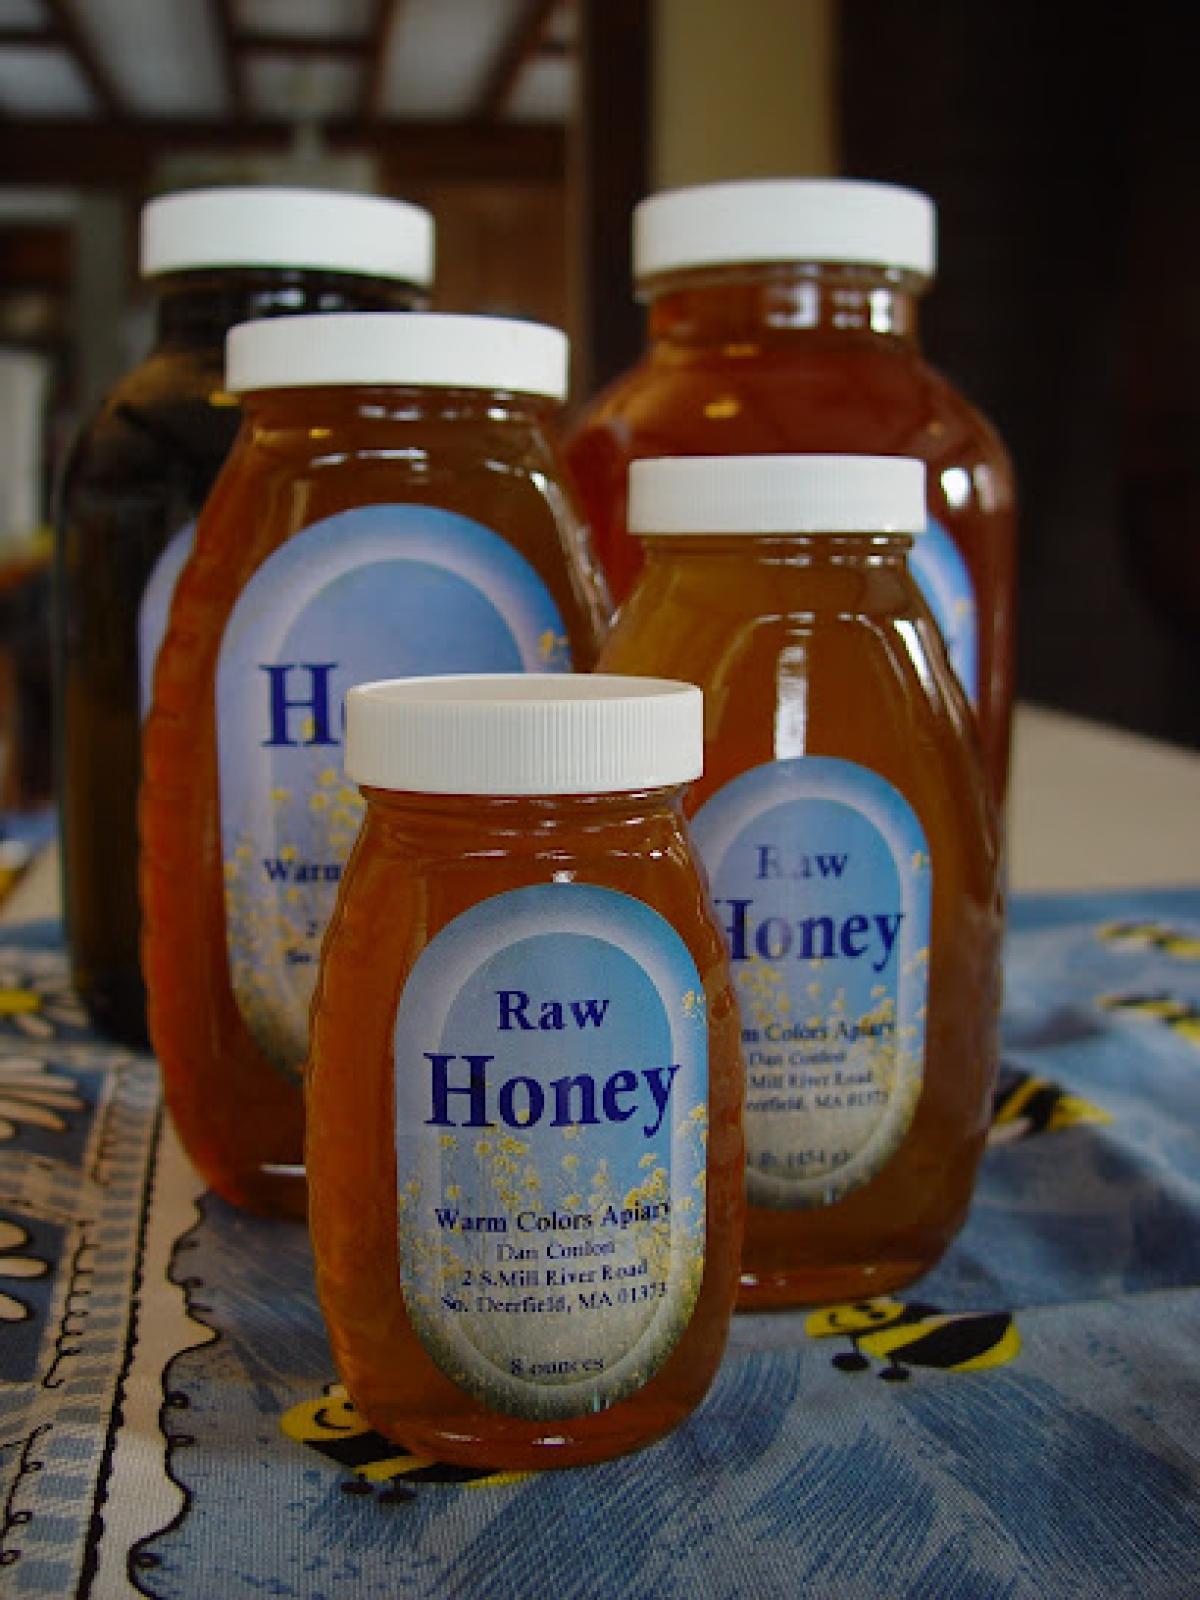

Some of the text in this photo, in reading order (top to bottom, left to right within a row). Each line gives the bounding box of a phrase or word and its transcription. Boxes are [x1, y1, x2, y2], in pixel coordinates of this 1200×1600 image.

[258, 663, 346, 747] H
[496, 990, 610, 1031] Raw
[423, 1053, 681, 1138] Honey
[434, 1200, 671, 1233] Warm Colors Apiary
[496, 1243, 540, 1263] Dan
[546, 1268, 596, 1286] River
[602, 1258, 649, 1282] Road
[578, 1291, 614, 1310] MA
[617, 1281, 669, 1304] 01373
[510, 1358, 605, 1376] 8 ounces
